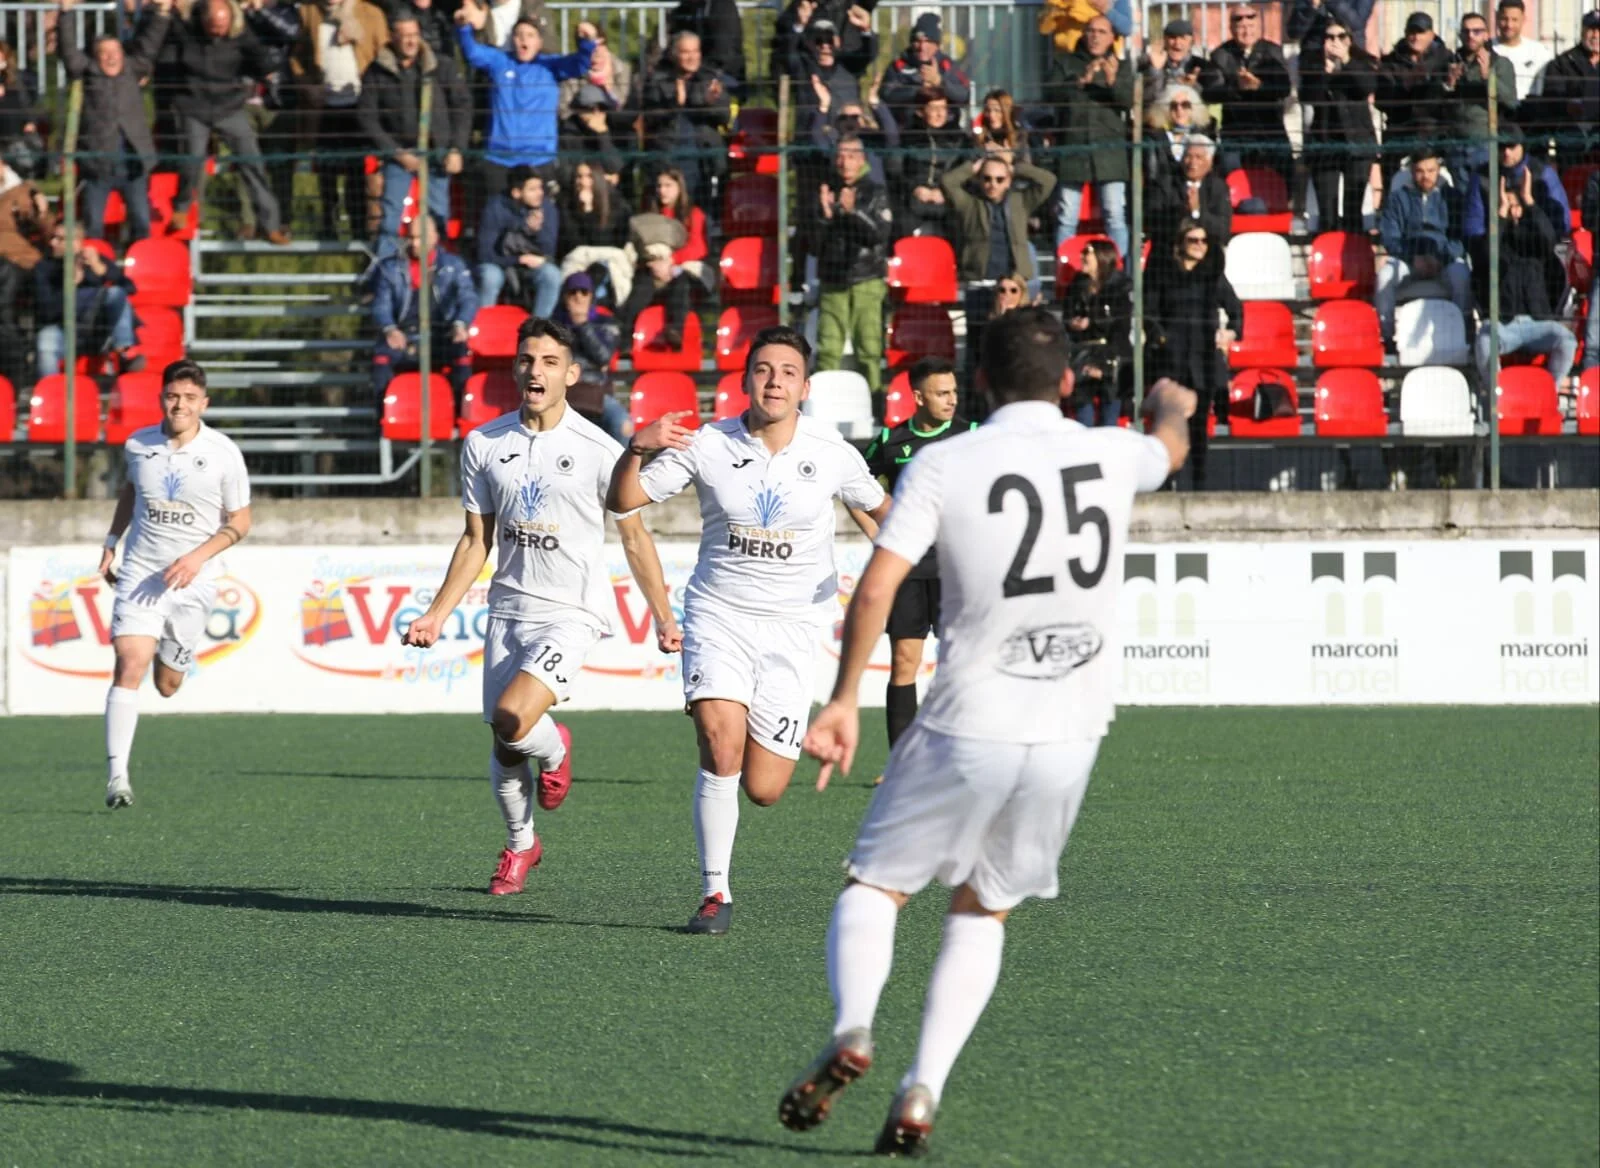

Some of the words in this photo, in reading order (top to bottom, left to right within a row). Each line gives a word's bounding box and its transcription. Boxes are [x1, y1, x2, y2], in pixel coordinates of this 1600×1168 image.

[148, 508, 195, 526] PIERO
[987, 463, 1111, 598] 25
[503, 525, 560, 552] PIERO
[728, 533, 793, 560] PIERO
[534, 645, 562, 672] 18
[1123, 639, 1210, 659] marconi
[1312, 637, 1398, 658] marconi
[1500, 637, 1588, 657] marconi
[1123, 660, 1210, 693] hotel
[1312, 660, 1399, 693] hotel
[1500, 659, 1589, 692] hotel
[772, 717, 799, 747] 21
